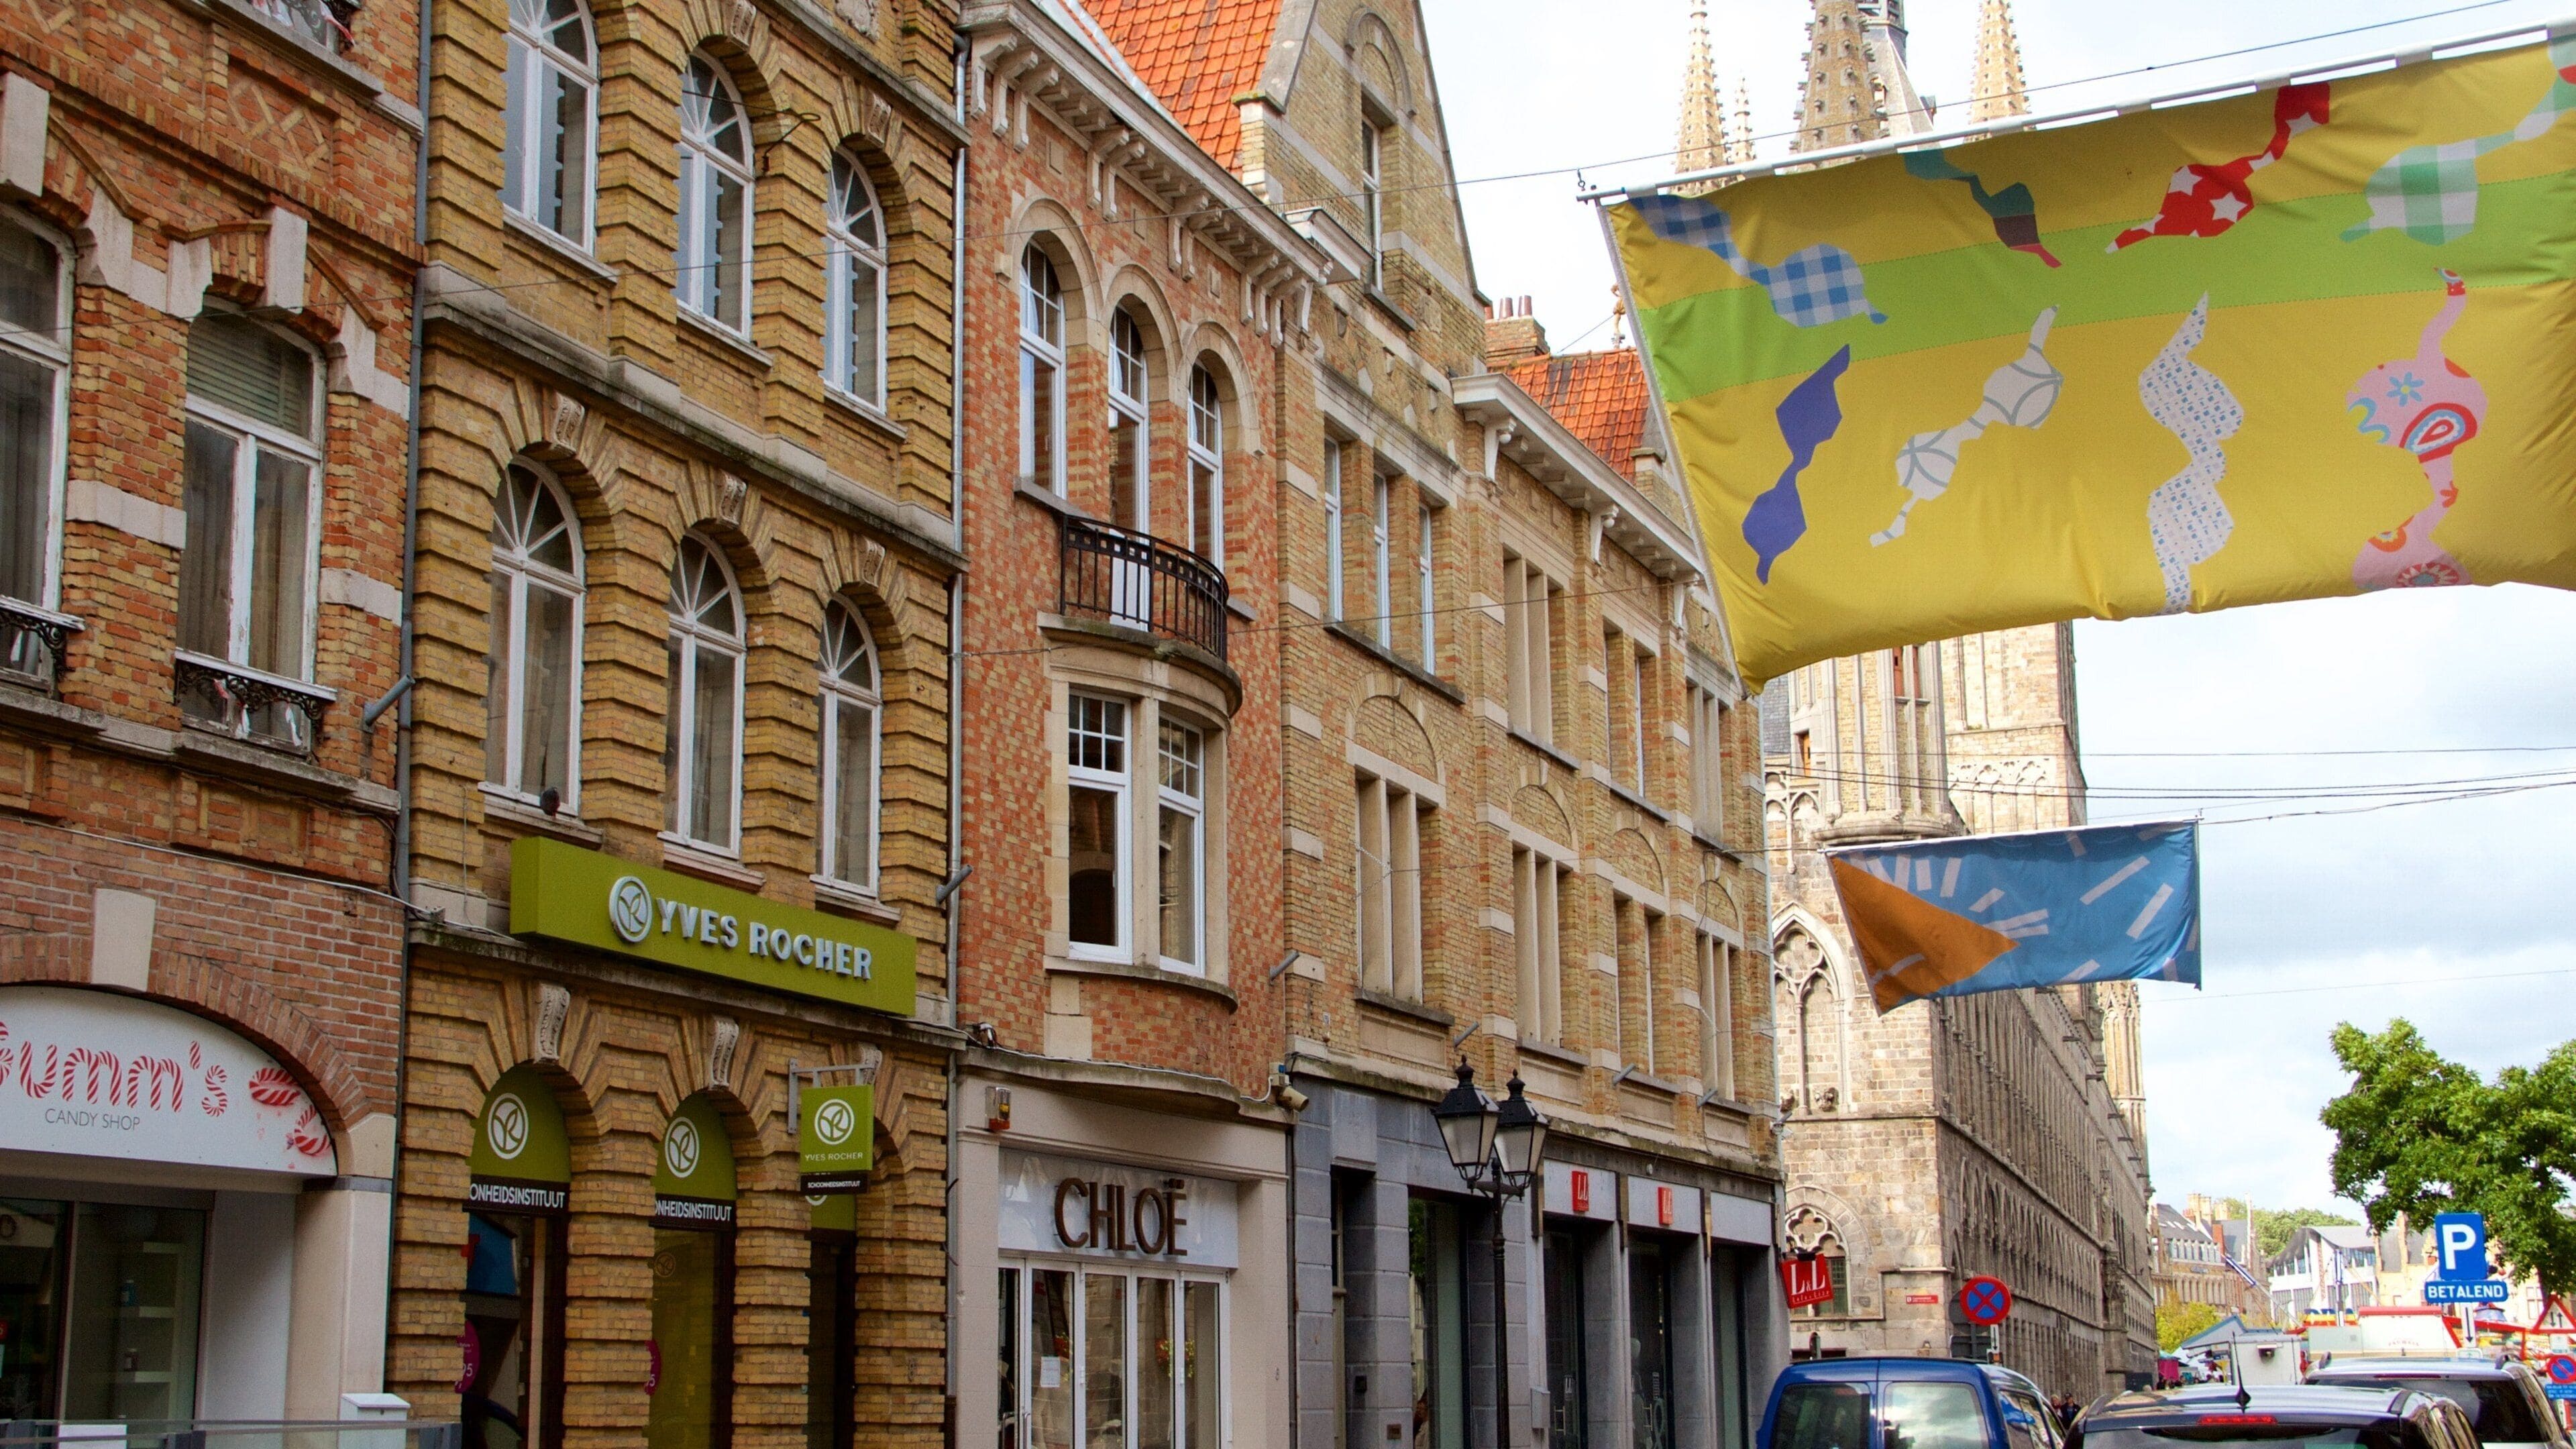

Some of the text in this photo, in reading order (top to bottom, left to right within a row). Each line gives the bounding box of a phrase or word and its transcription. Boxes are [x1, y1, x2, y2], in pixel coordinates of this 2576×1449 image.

[656, 898, 871, 981] YVES ROCHER
[44, 1108, 141, 1130] CANDY SHOP
[805, 1152, 863, 1162] YVES ROCHER
[470, 1183, 566, 1208] ONHEIDSINSTITUUT
[1054, 1177, 1188, 1256] CHLOË
[2442, 1224, 2477, 1270] P
[1790, 1260, 1825, 1296] L&L
[2427, 1285, 2504, 1299] BETALEND
